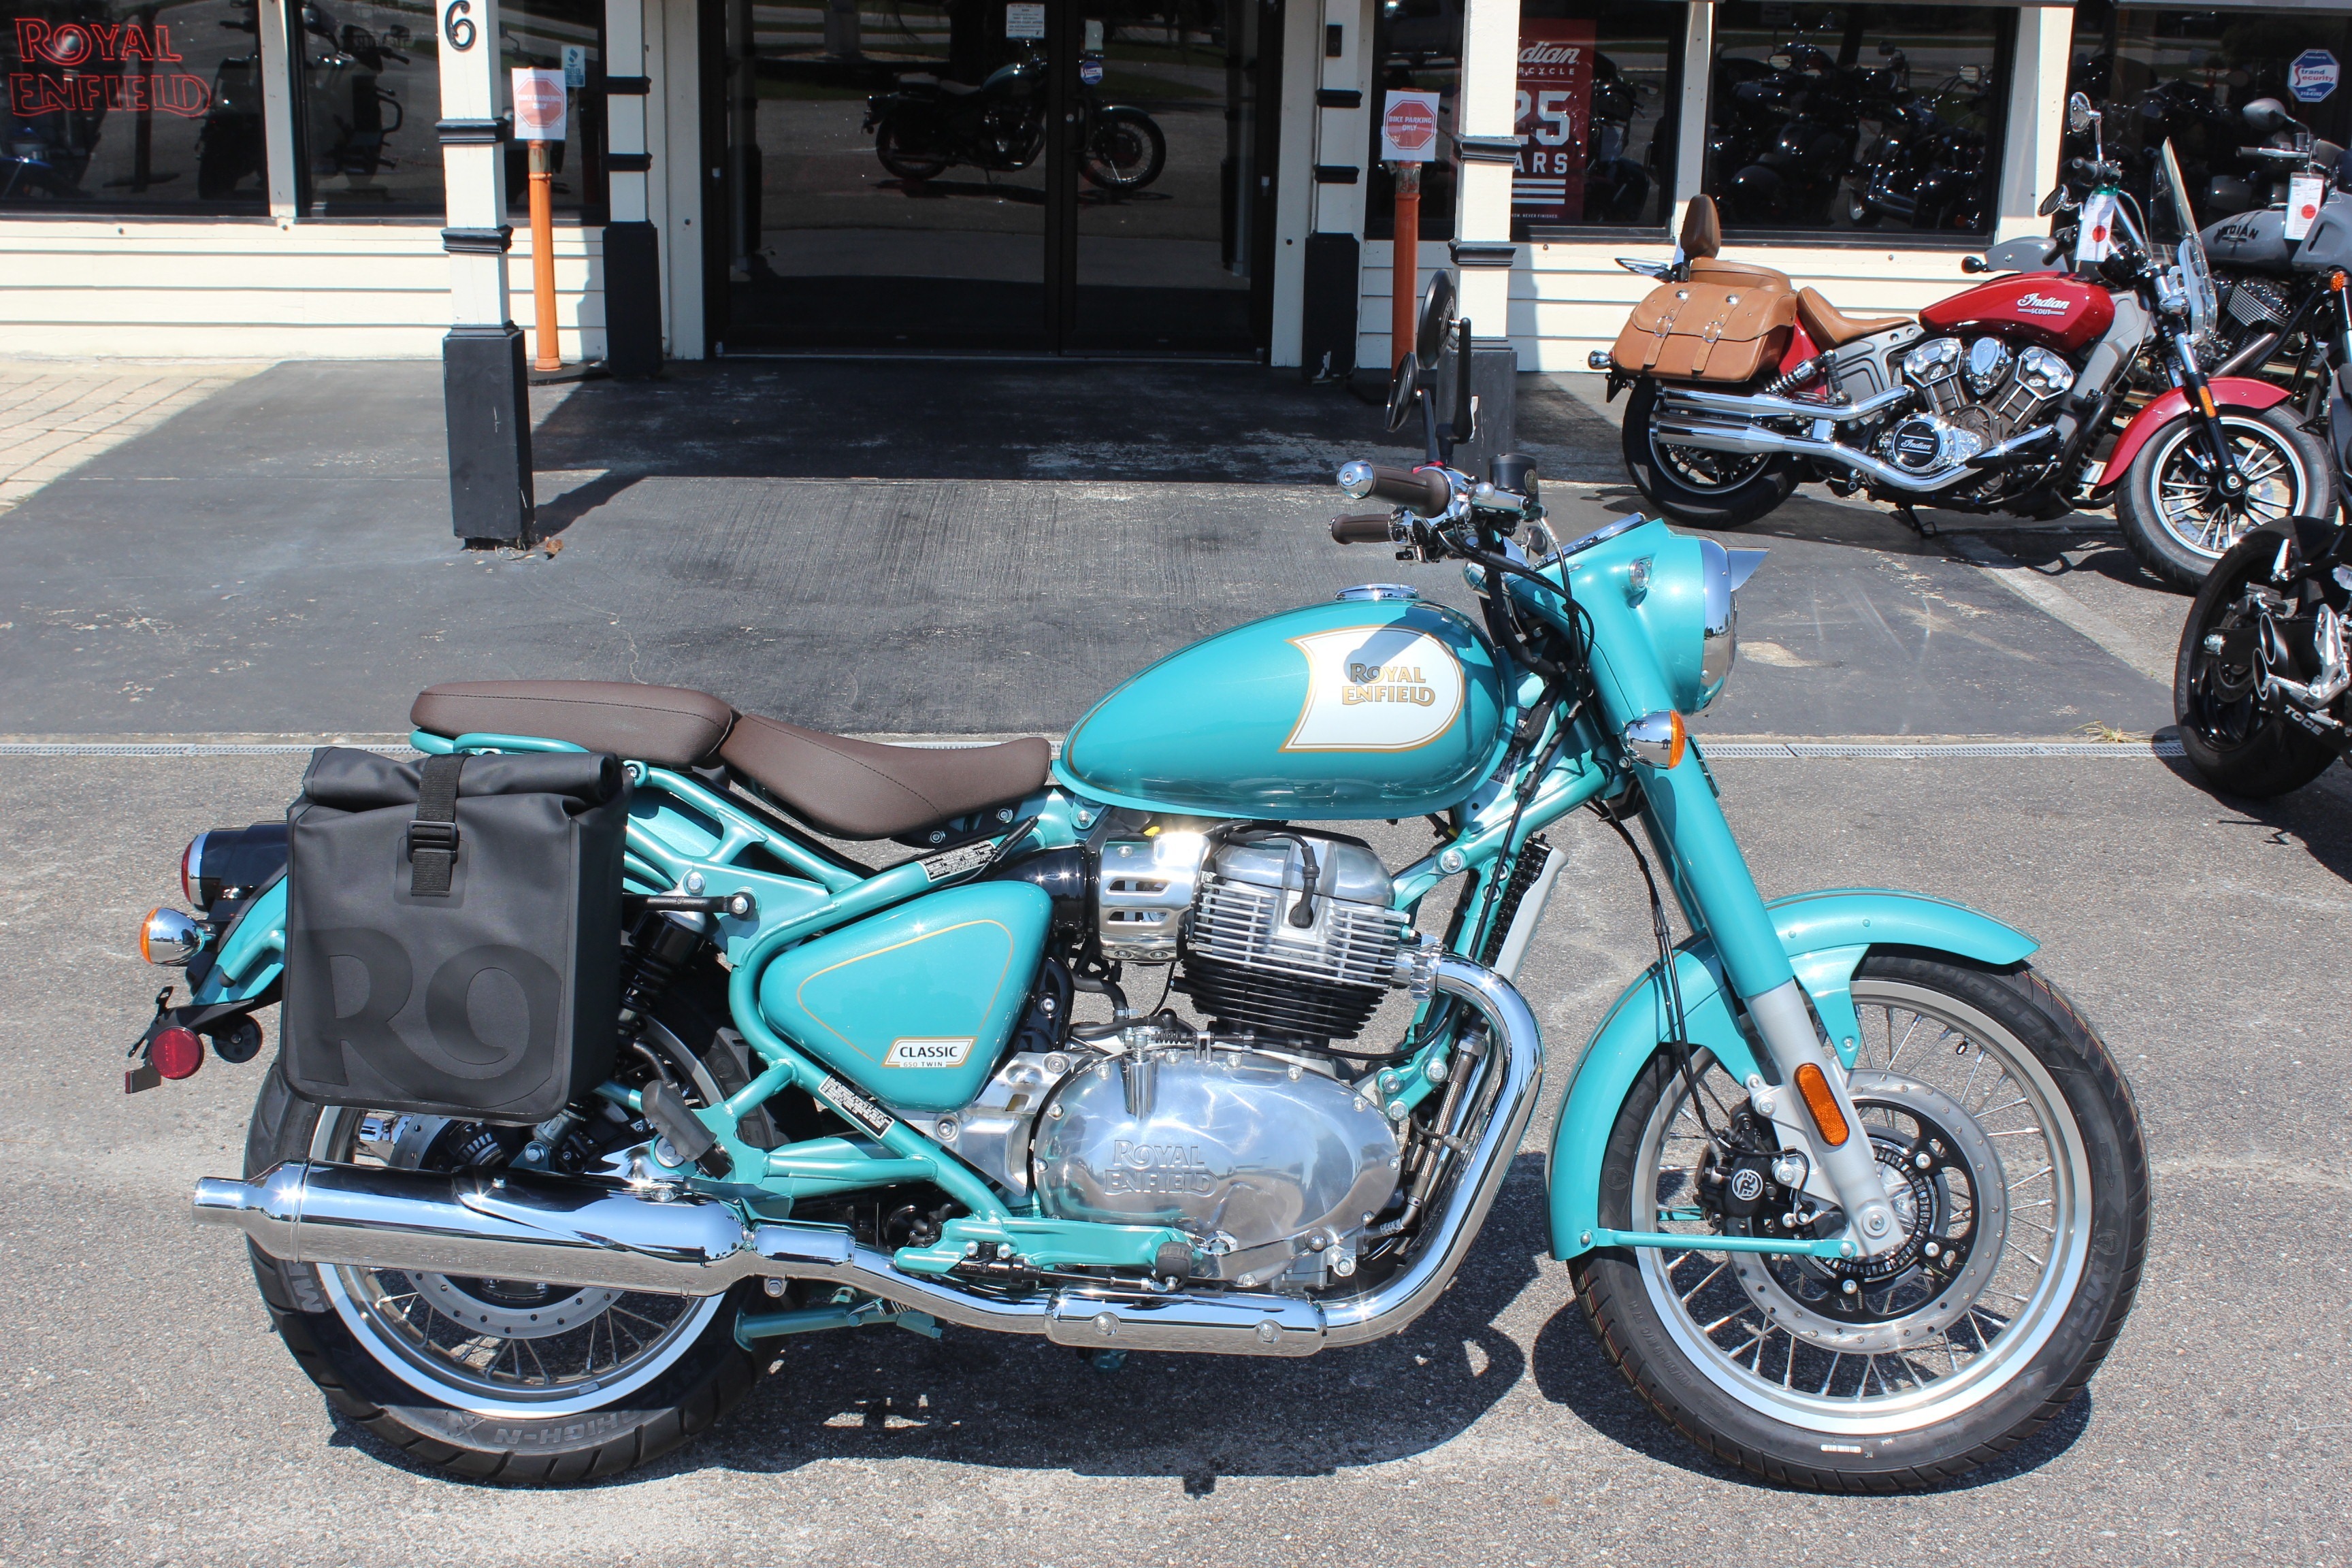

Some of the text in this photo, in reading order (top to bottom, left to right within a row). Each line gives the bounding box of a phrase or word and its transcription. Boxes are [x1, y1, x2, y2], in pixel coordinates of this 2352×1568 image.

[444, 0, 477, 52] 6
[14, 18, 183, 66] ROYAL
[1517, 41, 1580, 64] dian
[8, 73, 212, 118] ENFIELD
[2016, 293, 2070, 310] Indian
[1900, 439, 1932, 451] Indian
[1350, 663, 1426, 684] ROYAL
[1342, 685, 1436, 707] ENFIELD
[2284, 704, 2325, 736] TOCE
[899, 1046, 958, 1058] CLASSIC
[1113, 1139, 1205, 1170] ROYAL
[1105, 1170, 1219, 1198] ENFIELD
